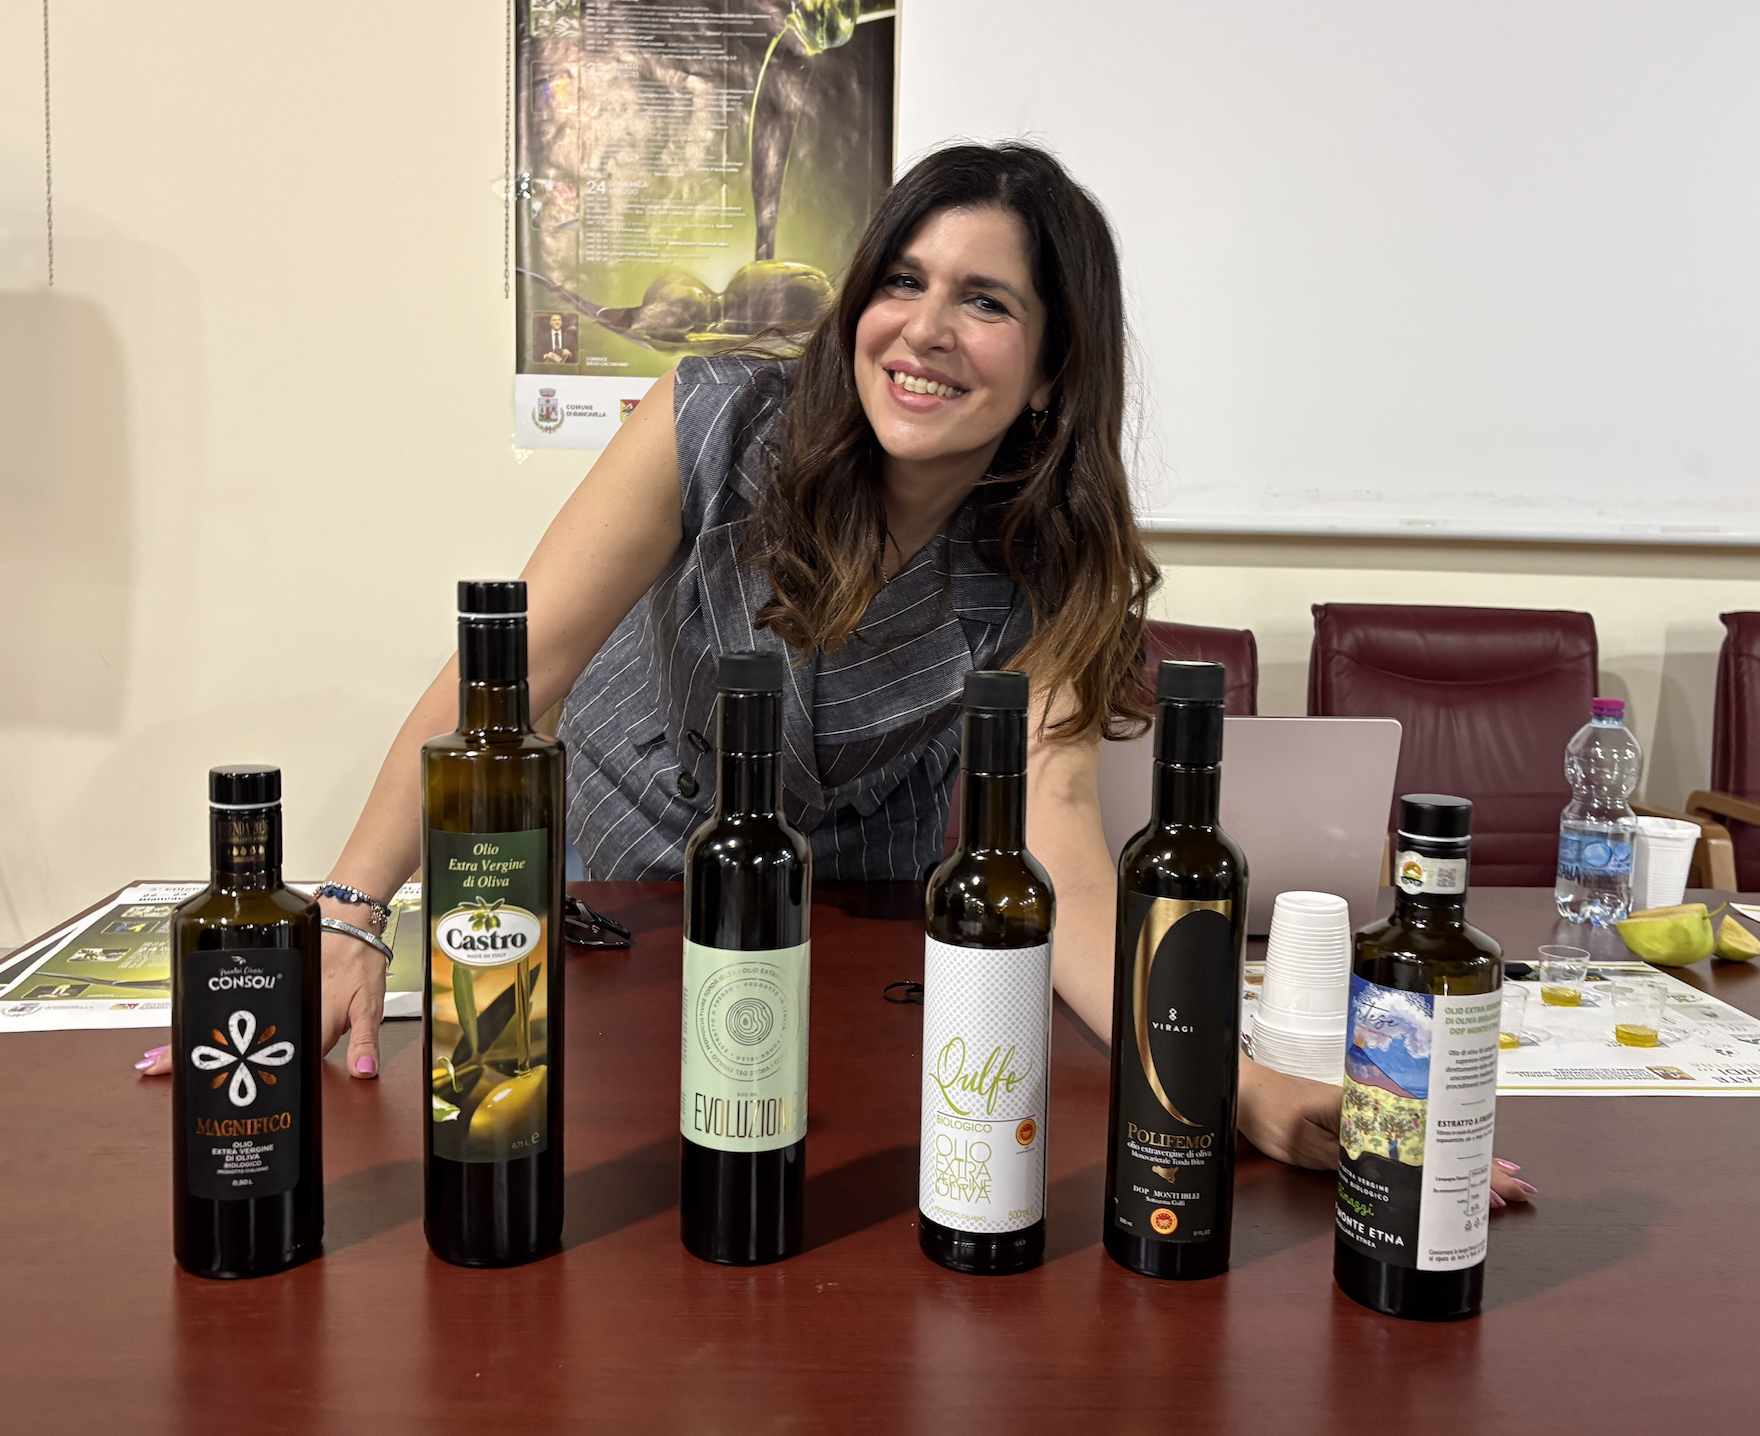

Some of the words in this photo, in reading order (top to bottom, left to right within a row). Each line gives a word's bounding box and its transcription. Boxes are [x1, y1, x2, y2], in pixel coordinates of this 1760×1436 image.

[586, 180, 606, 194] 24
[472, 843, 499, 856] Olio
[448, 858, 478, 872] Extra
[481, 858, 526, 874] Vergine
[463, 876, 475, 888] di
[478, 876, 510, 888] Oliva
[446, 928, 527, 951] Castro
[1445, 1007, 1464, 1015] OLIO
[1152, 1022, 1194, 1033] VIRAGI
[1456, 1017, 1477, 1025] OLIVA
[196, 1112, 291, 1137] MAGNIFICO
[936, 1115, 993, 1134] BIOLOGICO
[1438, 1118, 1474, 1128] ESTRATTO
[1127, 1121, 1212, 1149] POLIFEMO
[211, 1148, 239, 1156] EXTRA
[240, 1144, 275, 1154] VERGINE
[232, 1140, 254, 1149] OLIO
[936, 1134, 992, 1164] OLIO
[1127, 1140, 1140, 1151] olio
[1187, 1150, 1194, 1158] di
[224, 1160, 262, 1169] BIOLOGICO
[235, 1153, 261, 1162] OLIVA
[936, 1152, 993, 1182] EXTRA
[1133, 1184, 1150, 1196] DOP
[1153, 1190, 1180, 1200] MONTI
[1350, 1180, 1390, 1203] BIOLOGICO
[1357, 1176, 1390, 1194] VERGINE
[1356, 1234, 1377, 1249] ETNEA
[1368, 1226, 1405, 1247] ETNA
